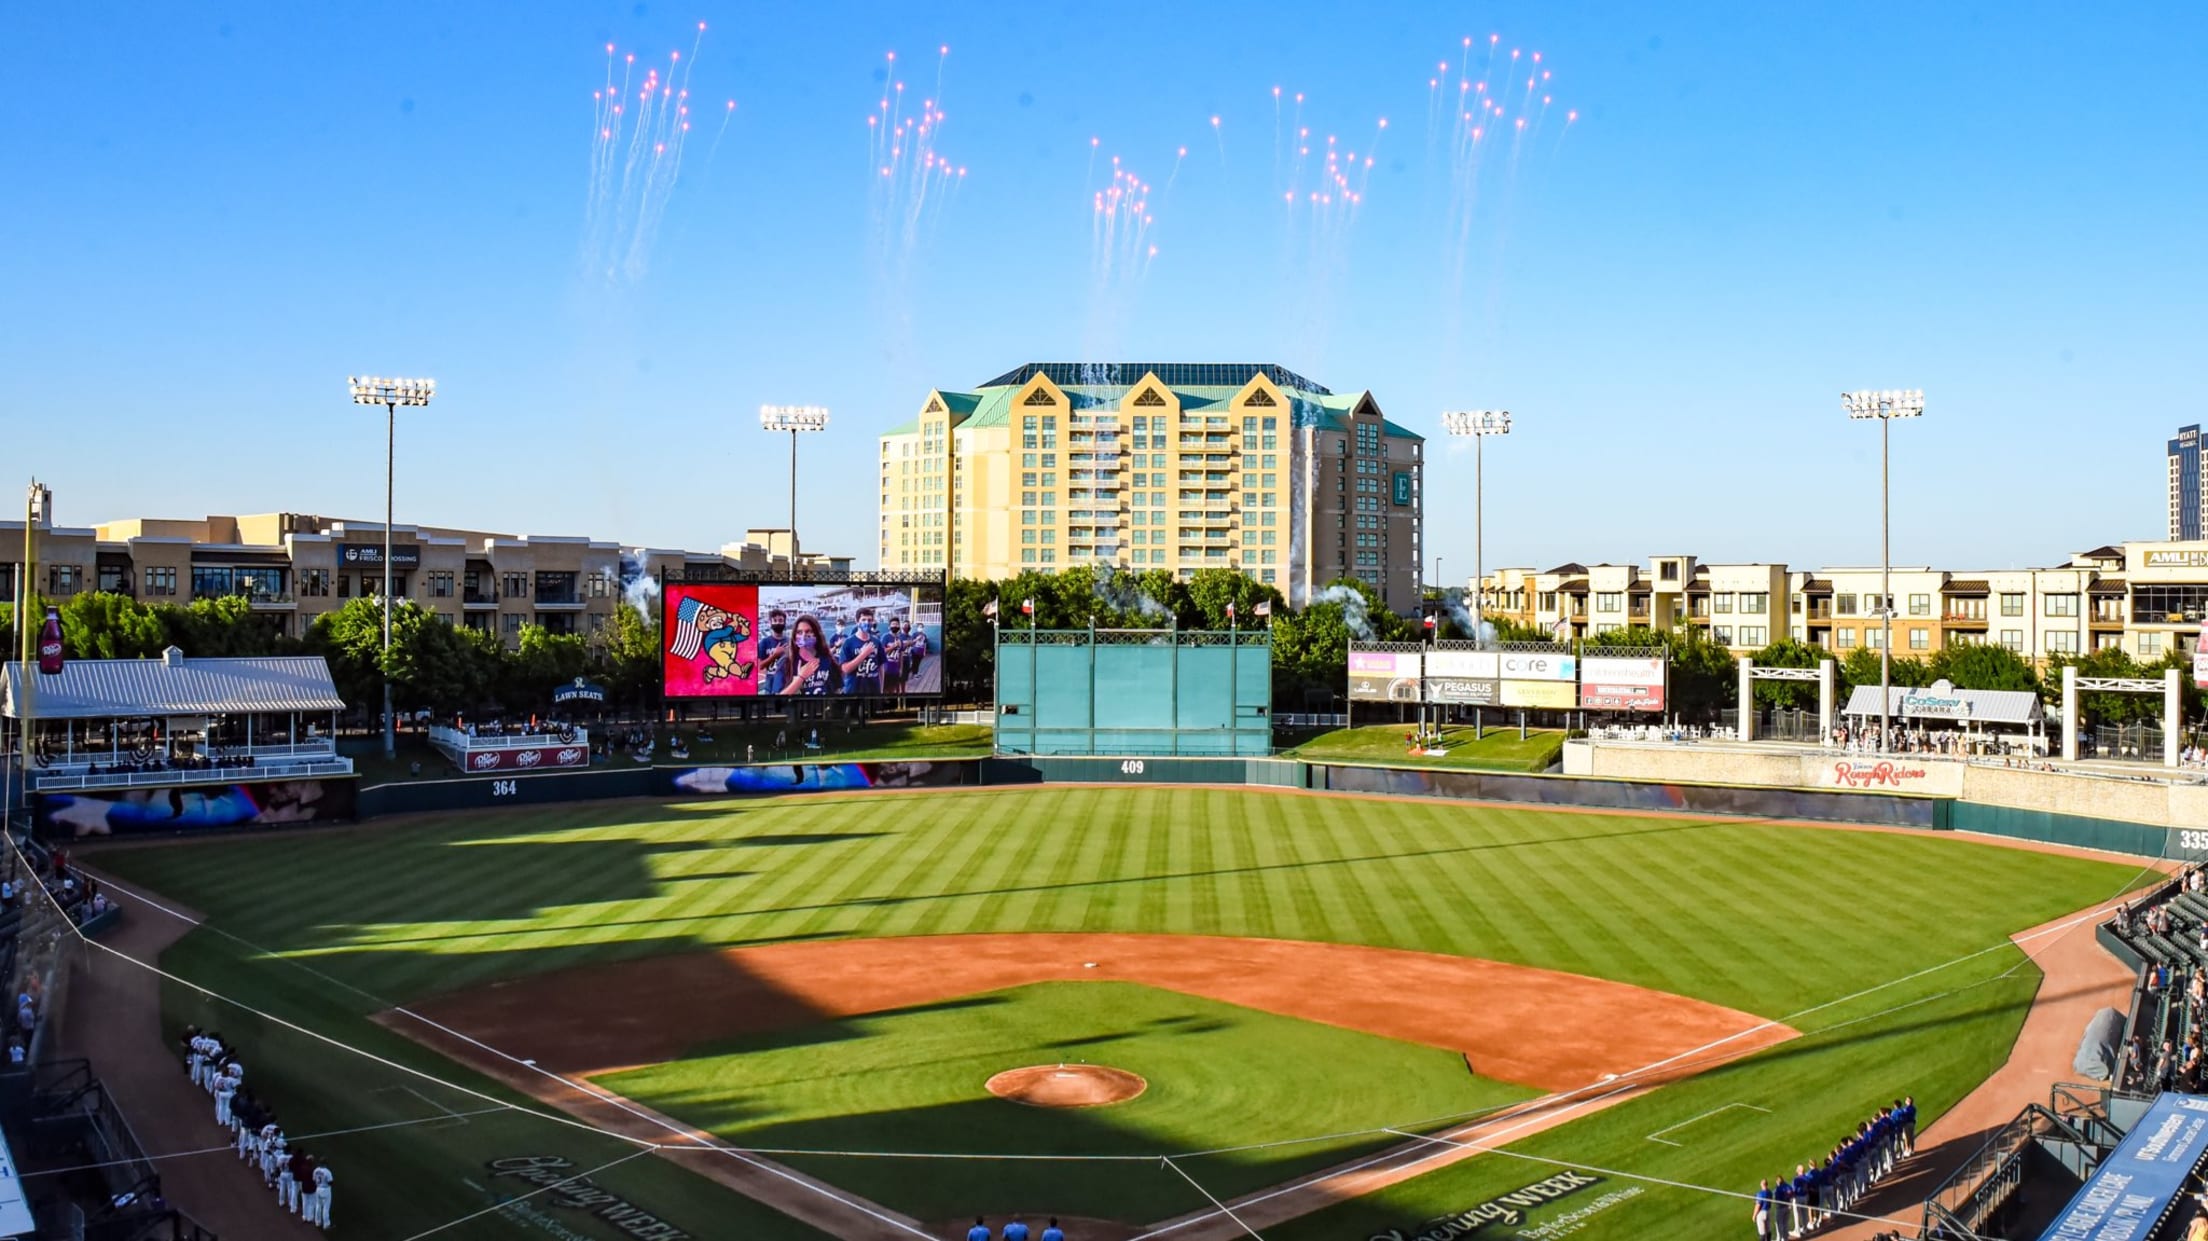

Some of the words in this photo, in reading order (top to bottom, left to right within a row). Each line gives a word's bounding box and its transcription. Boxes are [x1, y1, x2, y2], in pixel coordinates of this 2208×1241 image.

[1506, 659, 1547, 672] core
[1444, 682, 1492, 692] PEGASUS
[555, 691, 578, 703] LAWN
[578, 691, 603, 701] SEATS
[1121, 760, 1144, 774] 409
[493, 780, 517, 796] 364
[2180, 830, 2208, 850] 335
[1499, 1170, 1598, 1206] WEEK
